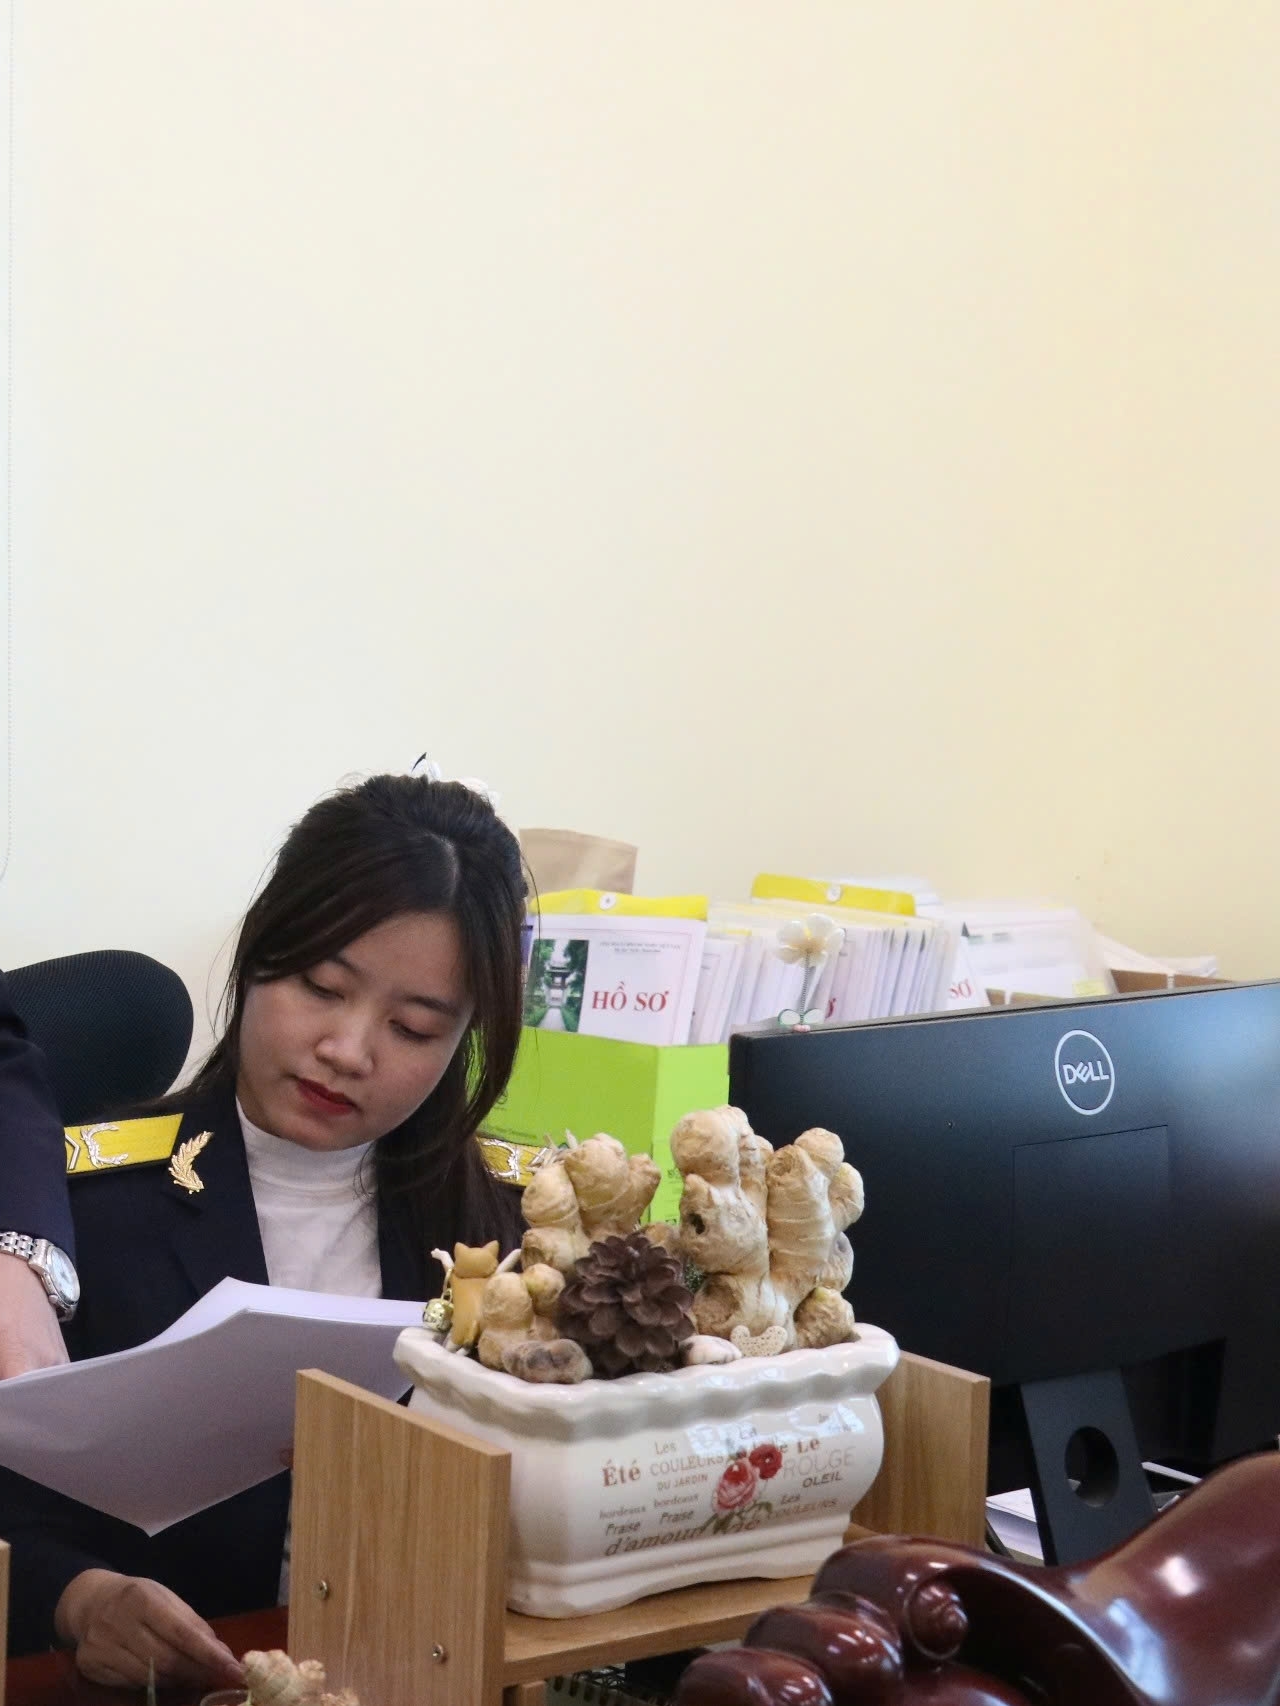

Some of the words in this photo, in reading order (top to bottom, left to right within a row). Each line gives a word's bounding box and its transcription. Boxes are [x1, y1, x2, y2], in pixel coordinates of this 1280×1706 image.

[592, 981, 627, 1011] HỒ
[634, 990, 669, 1012] SƠ
[1062, 1060, 1110, 1085] DELL
[796, 1438, 820, 1454] Le
[602, 1458, 641, 1488] Été
[649, 1454, 724, 1477] COULEURS
[674, 1473, 708, 1488] JARDIN
[802, 1471, 843, 1488] OLEIL
